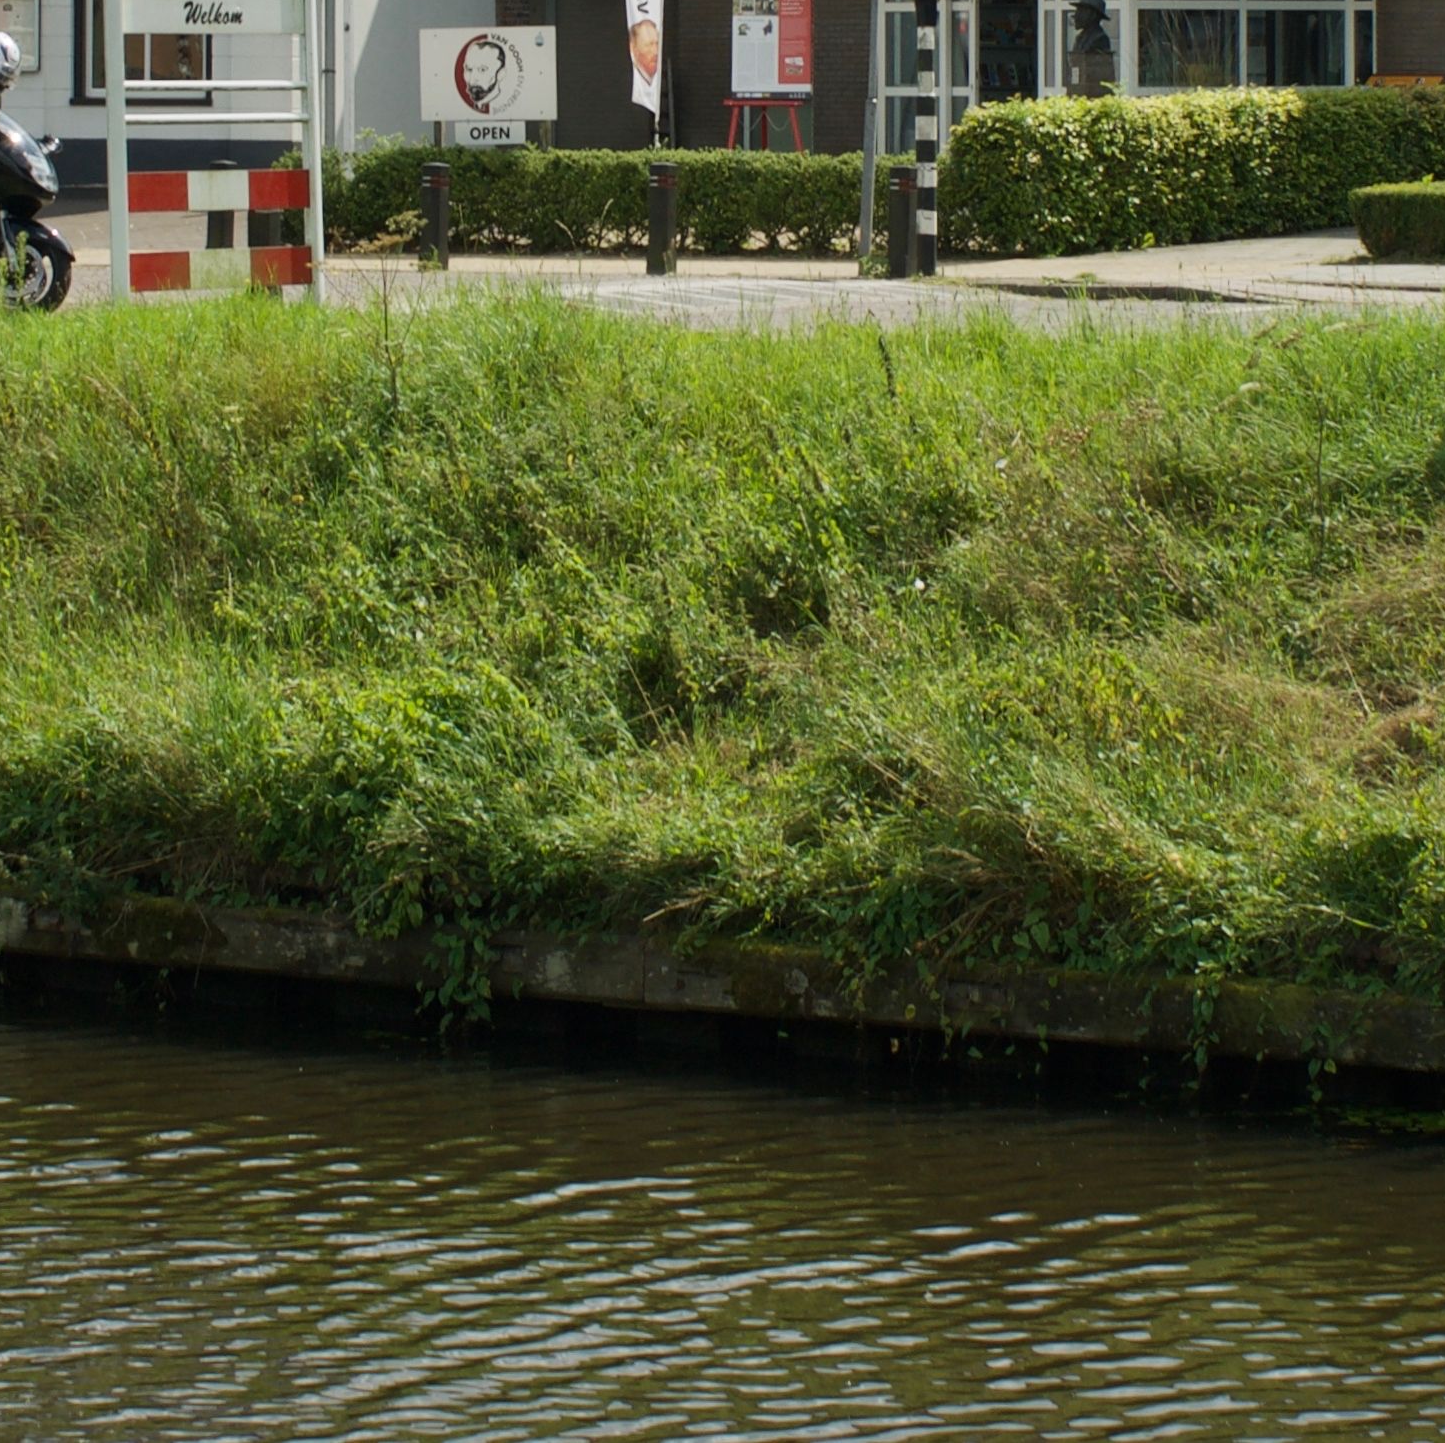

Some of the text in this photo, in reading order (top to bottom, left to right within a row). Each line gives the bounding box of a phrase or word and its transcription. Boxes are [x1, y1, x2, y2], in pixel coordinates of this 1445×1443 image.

[183, 0, 244, 25] Welkom
[490, 32, 509, 45] VAN
[470, 125, 511, 141] OPEN
